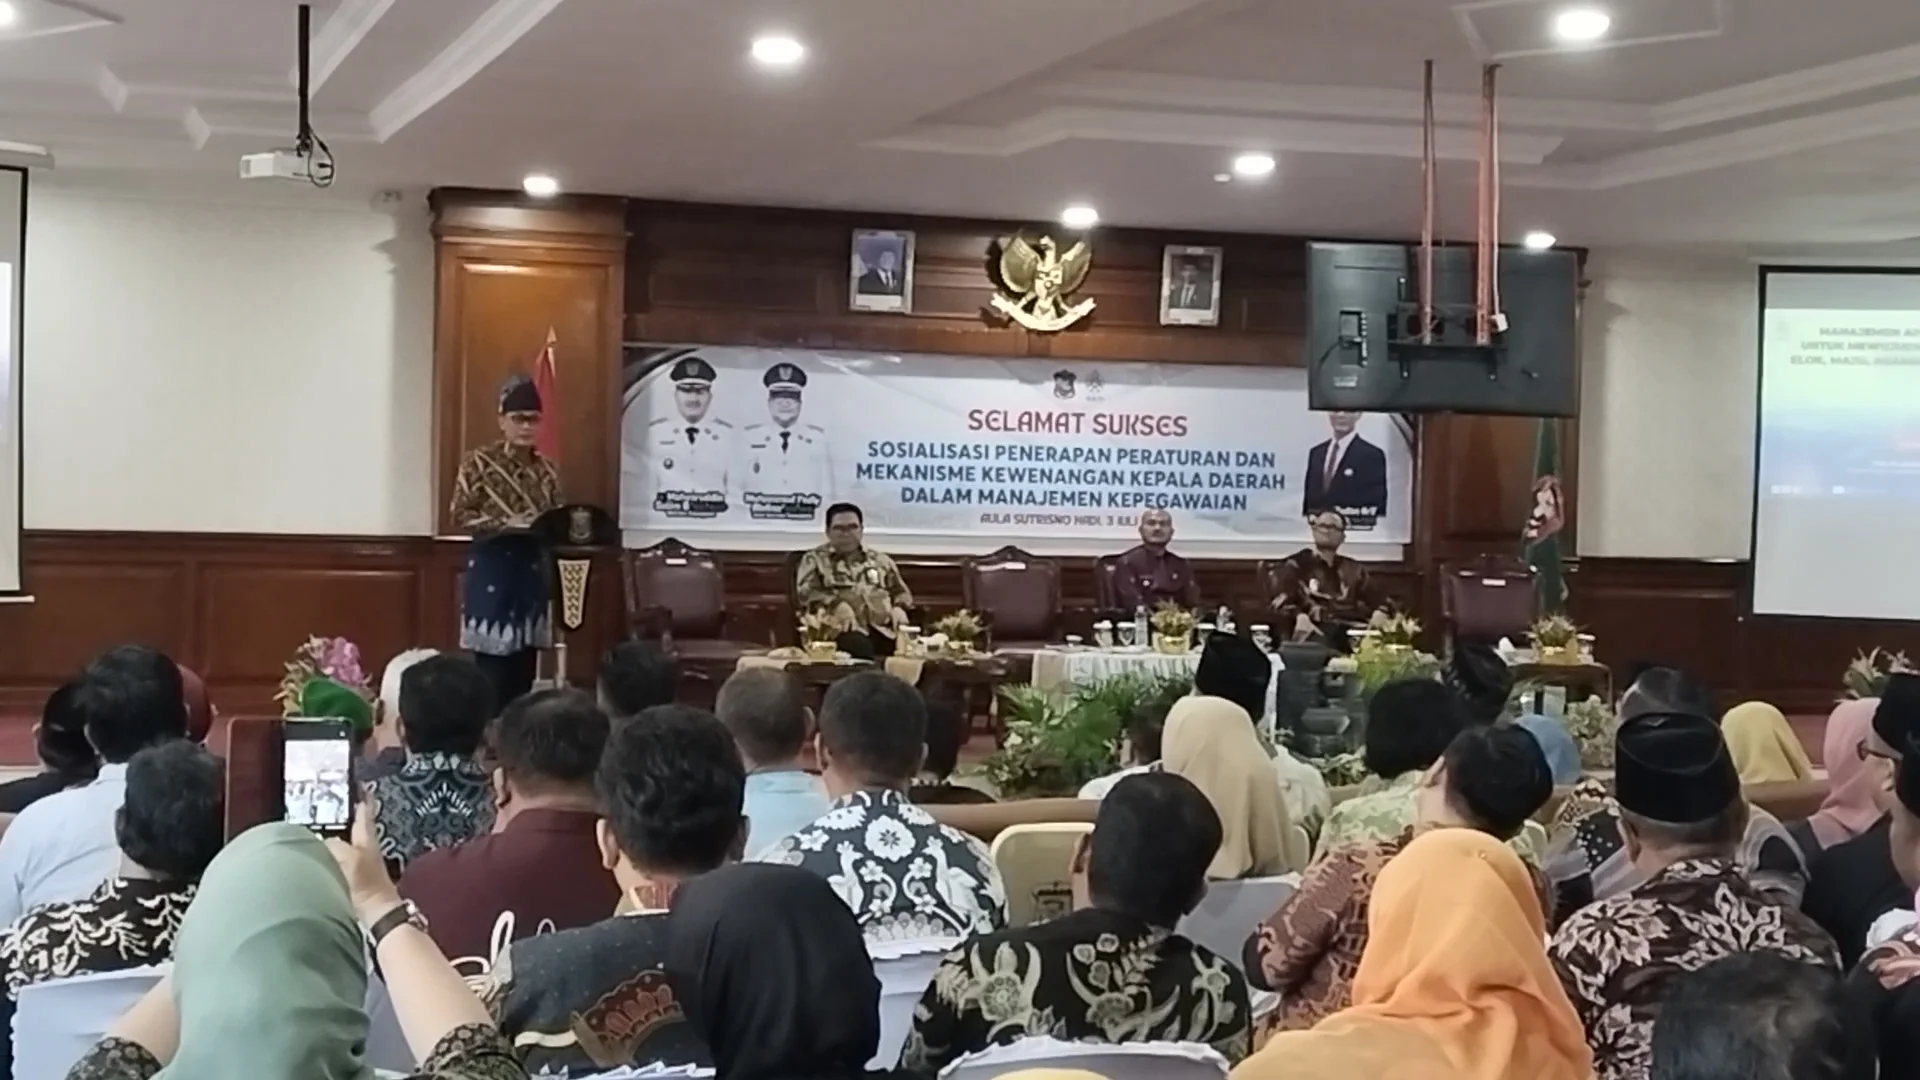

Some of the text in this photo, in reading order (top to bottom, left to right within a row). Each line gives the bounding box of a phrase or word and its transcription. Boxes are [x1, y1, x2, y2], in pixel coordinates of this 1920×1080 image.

[968, 409, 1188, 437] SELAMAT SUKSES
[868, 441, 1276, 469] SOSIALISASI PENERAPAN PERATURAN DAN
[856, 463, 1286, 490] MEKANISME KEWENANGAN KEPALA DAERAH
[901, 486, 1247, 511] DALAM MANAJEMEN KEPEGAWAIAN
[980, 513, 1011, 524] AULA
[1014, 514, 1071, 526] SUTRISNO
[1106, 516, 1114, 526] 3
